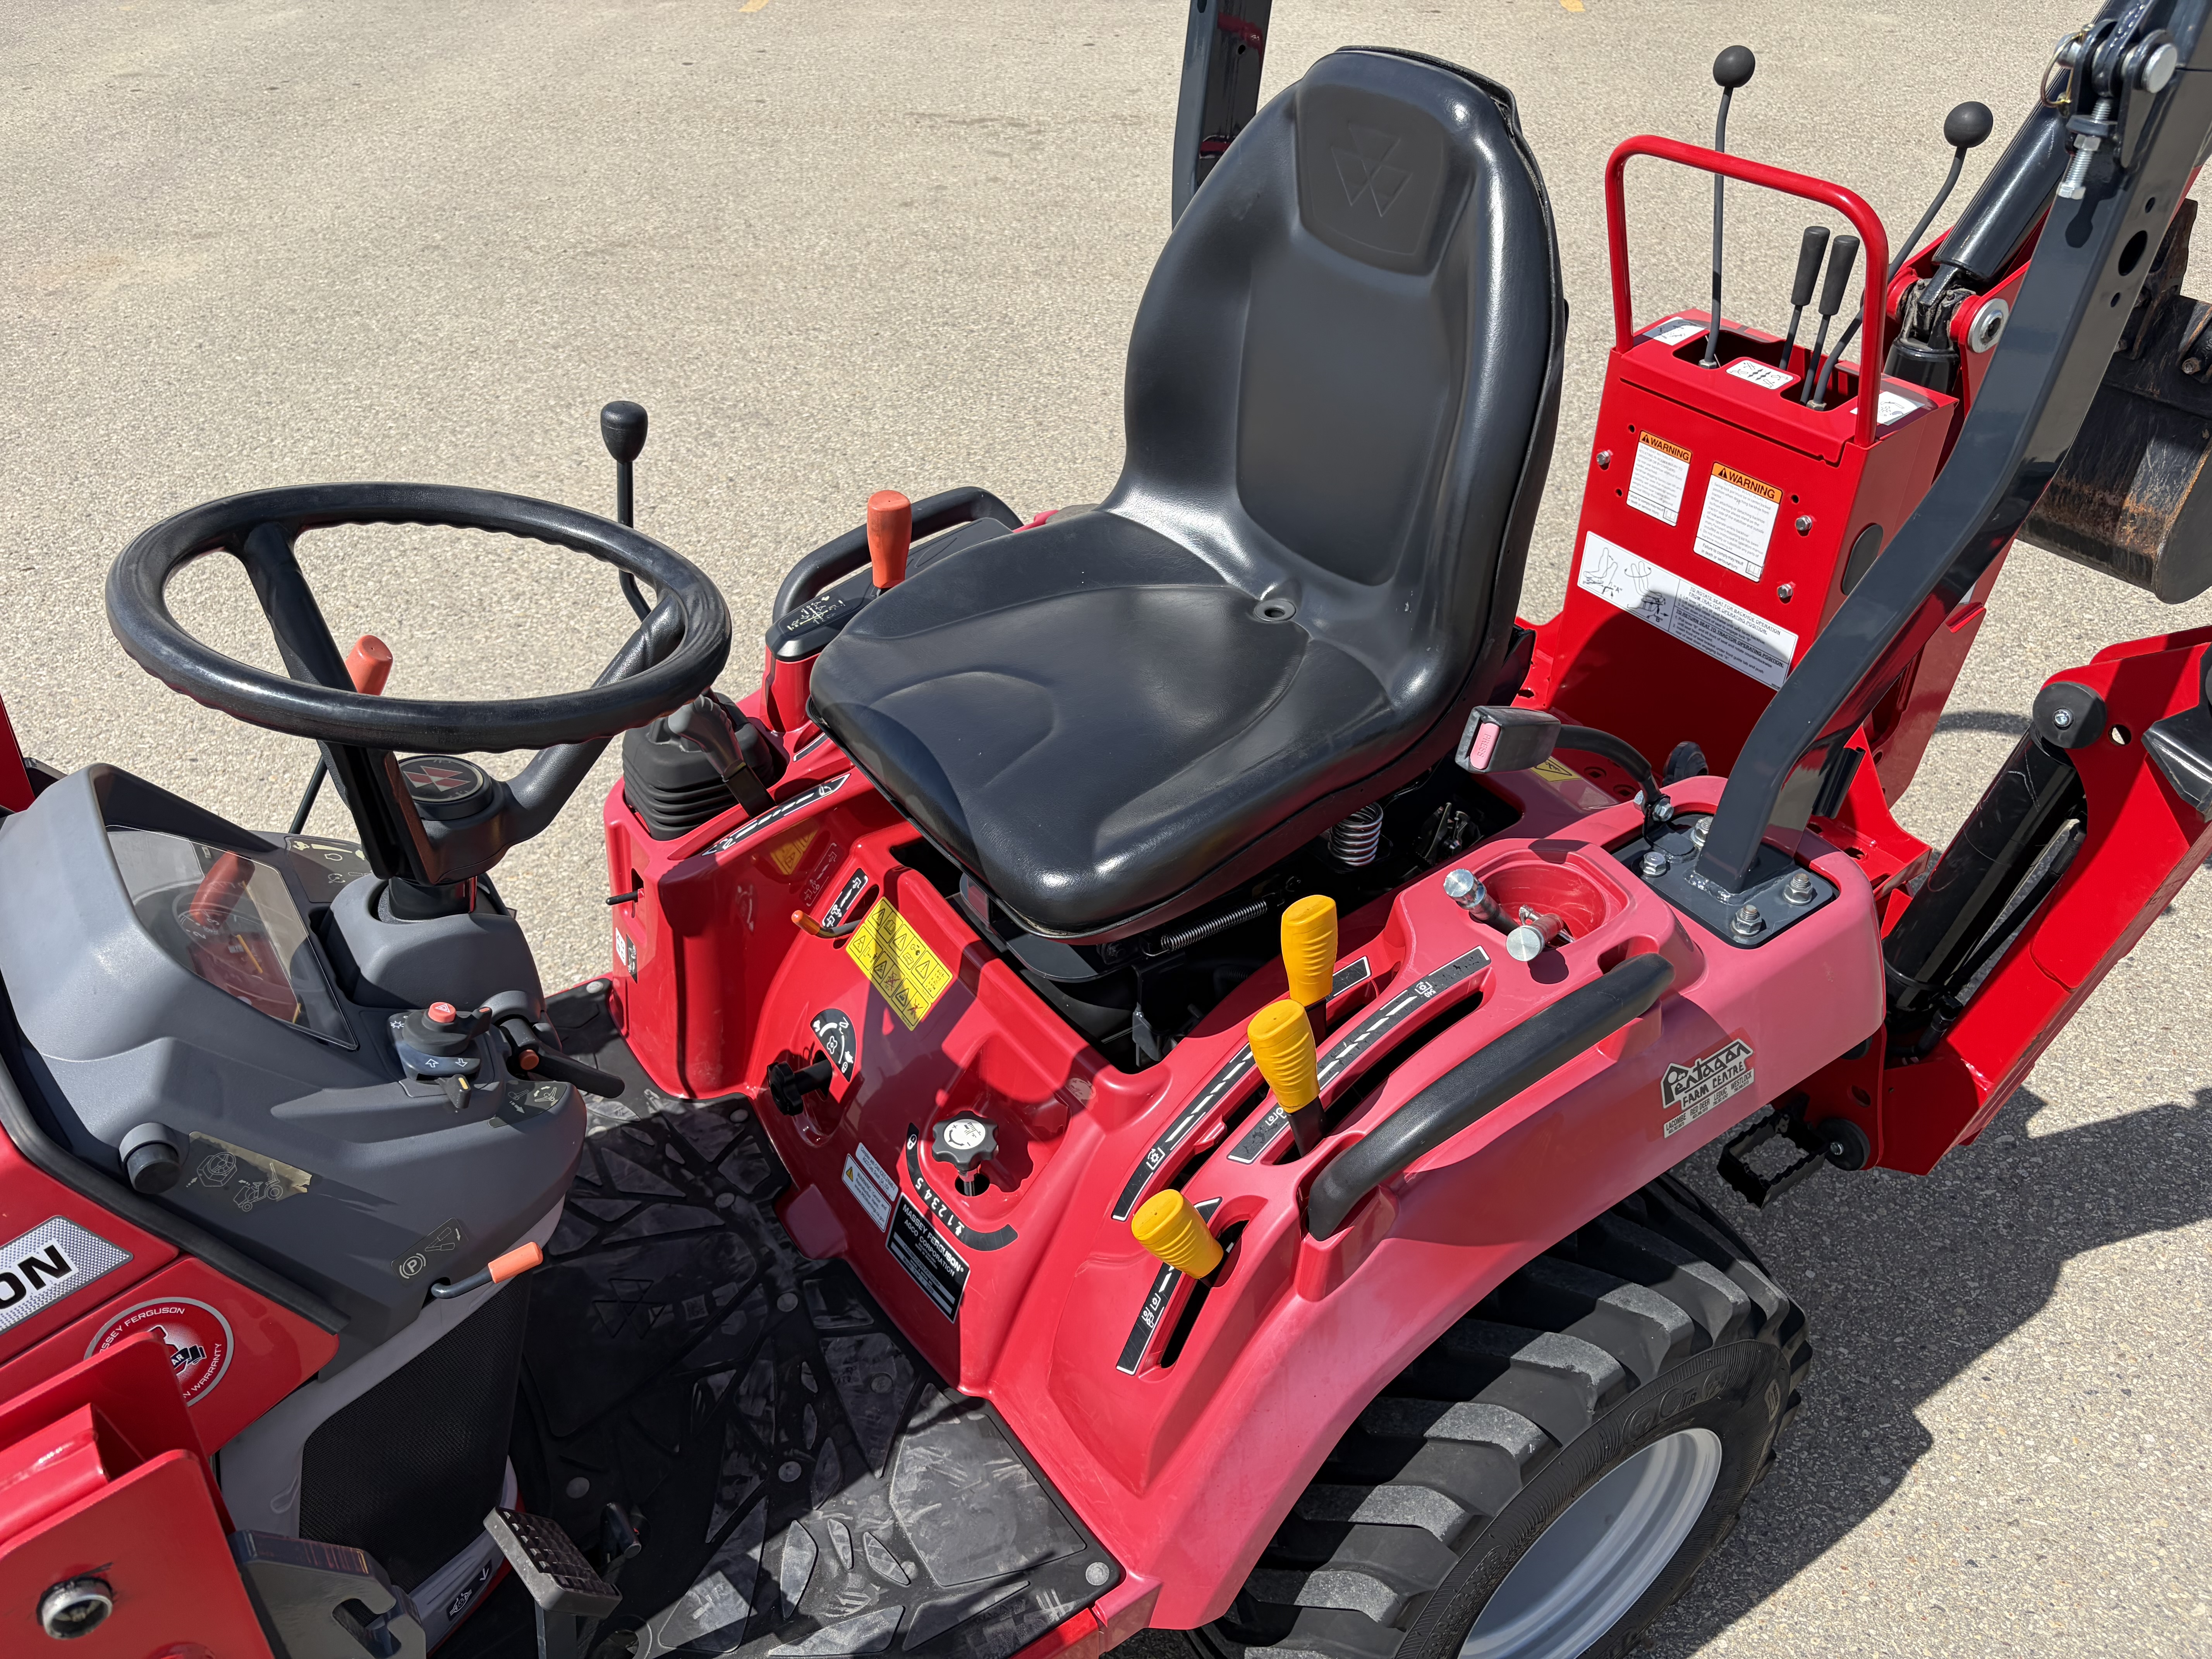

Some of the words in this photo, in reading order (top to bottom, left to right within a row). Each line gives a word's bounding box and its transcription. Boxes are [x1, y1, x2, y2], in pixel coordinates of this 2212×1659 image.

[1649, 437, 1690, 461] WARNING
[1728, 471, 1776, 500] WARNING
[1702, 543, 1713, 551] Failure
[1716, 550, 1728, 559] comply
[1688, 591, 1700, 601] FROM
[1701, 598, 1721, 611] TRACTOR
[1721, 608, 1746, 623] OPERATING
[1745, 620, 1768, 635] POSITION:
[1696, 589, 1712, 601] ROTATE
[1712, 598, 1724, 607] SEAT
[1733, 608, 1755, 622] BACKHOE
[1755, 619, 1781, 635] OPERATION
[1682, 612, 1698, 623] RETURN
[1699, 621, 1710, 629] SEAT
[1716, 630, 1737, 644] TRACTOR
[1737, 641, 1762, 656] OPERATING
[1762, 653, 1784, 668] POSITION:
[1477, 733, 1491, 757] PRESS
[1424, 988, 1436, 998] 540
[1666, 1113, 1686, 1131] LACOMBE
[1690, 1105, 1698, 1116] RED
[1699, 1098, 1710, 1110] DEER
[1714, 1087, 1727, 1101] LEDUC
[1730, 1071, 1752, 1090] WESTLOCK
[1683, 1085, 1709, 1107] FARM
[915, 1178, 924, 1190] 5
[924, 1189, 932, 1200] 4
[931, 1197, 940, 1210] 3
[939, 1204, 947, 1217] 2
[902, 1203, 928, 1236] MASSEY
[948, 1214, 954, 1225] 1
[904, 1218, 919, 1238] AGCO
[919, 1234, 955, 1278] CORPORATION
[124, 1307, 185, 1327] FERGUSON
[191, 1343, 222, 1391] WARRANTY
